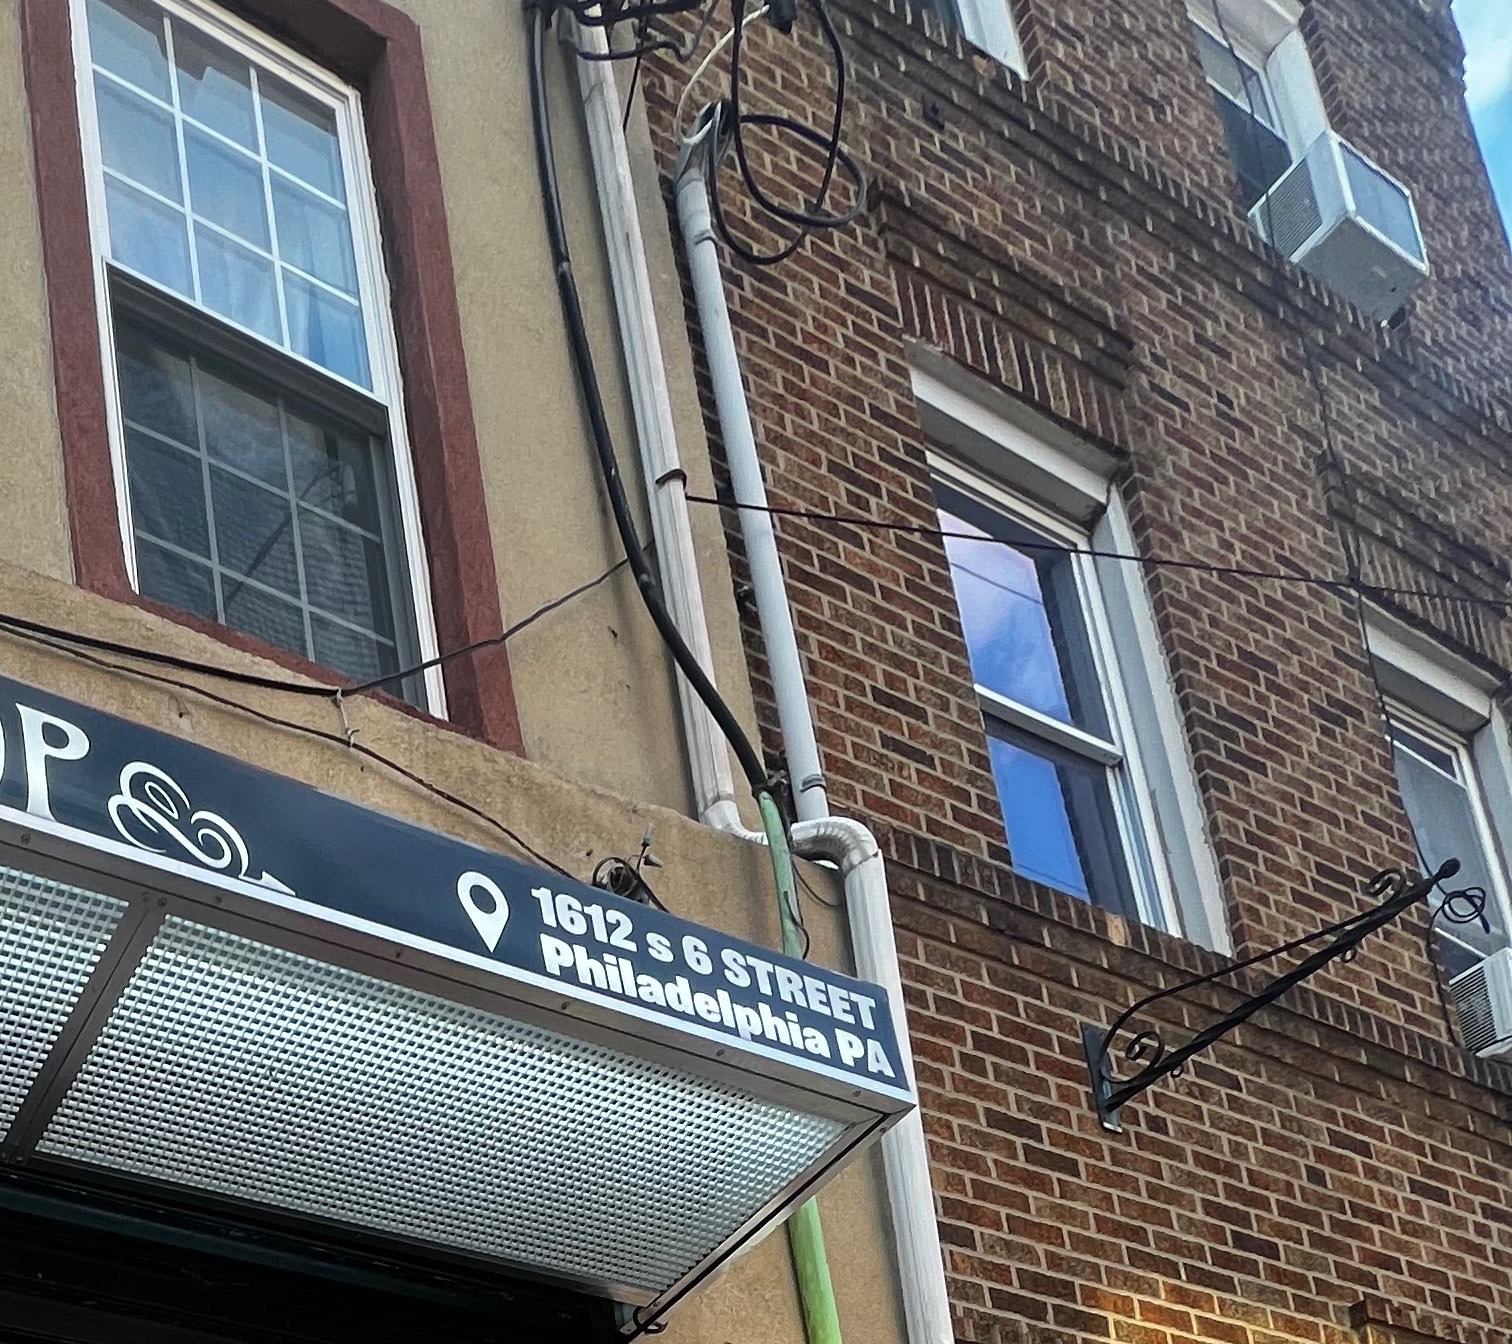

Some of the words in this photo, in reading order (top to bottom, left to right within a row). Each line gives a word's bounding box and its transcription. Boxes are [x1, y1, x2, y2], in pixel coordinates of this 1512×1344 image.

[531, 886, 639, 953] 1612
[647, 931, 674, 963] s
[683, 935, 713, 975] 6
[722, 947, 877, 1030] STREET
[540, 933, 831, 1058] Philadelphia
[838, 1031, 897, 1079] PA
